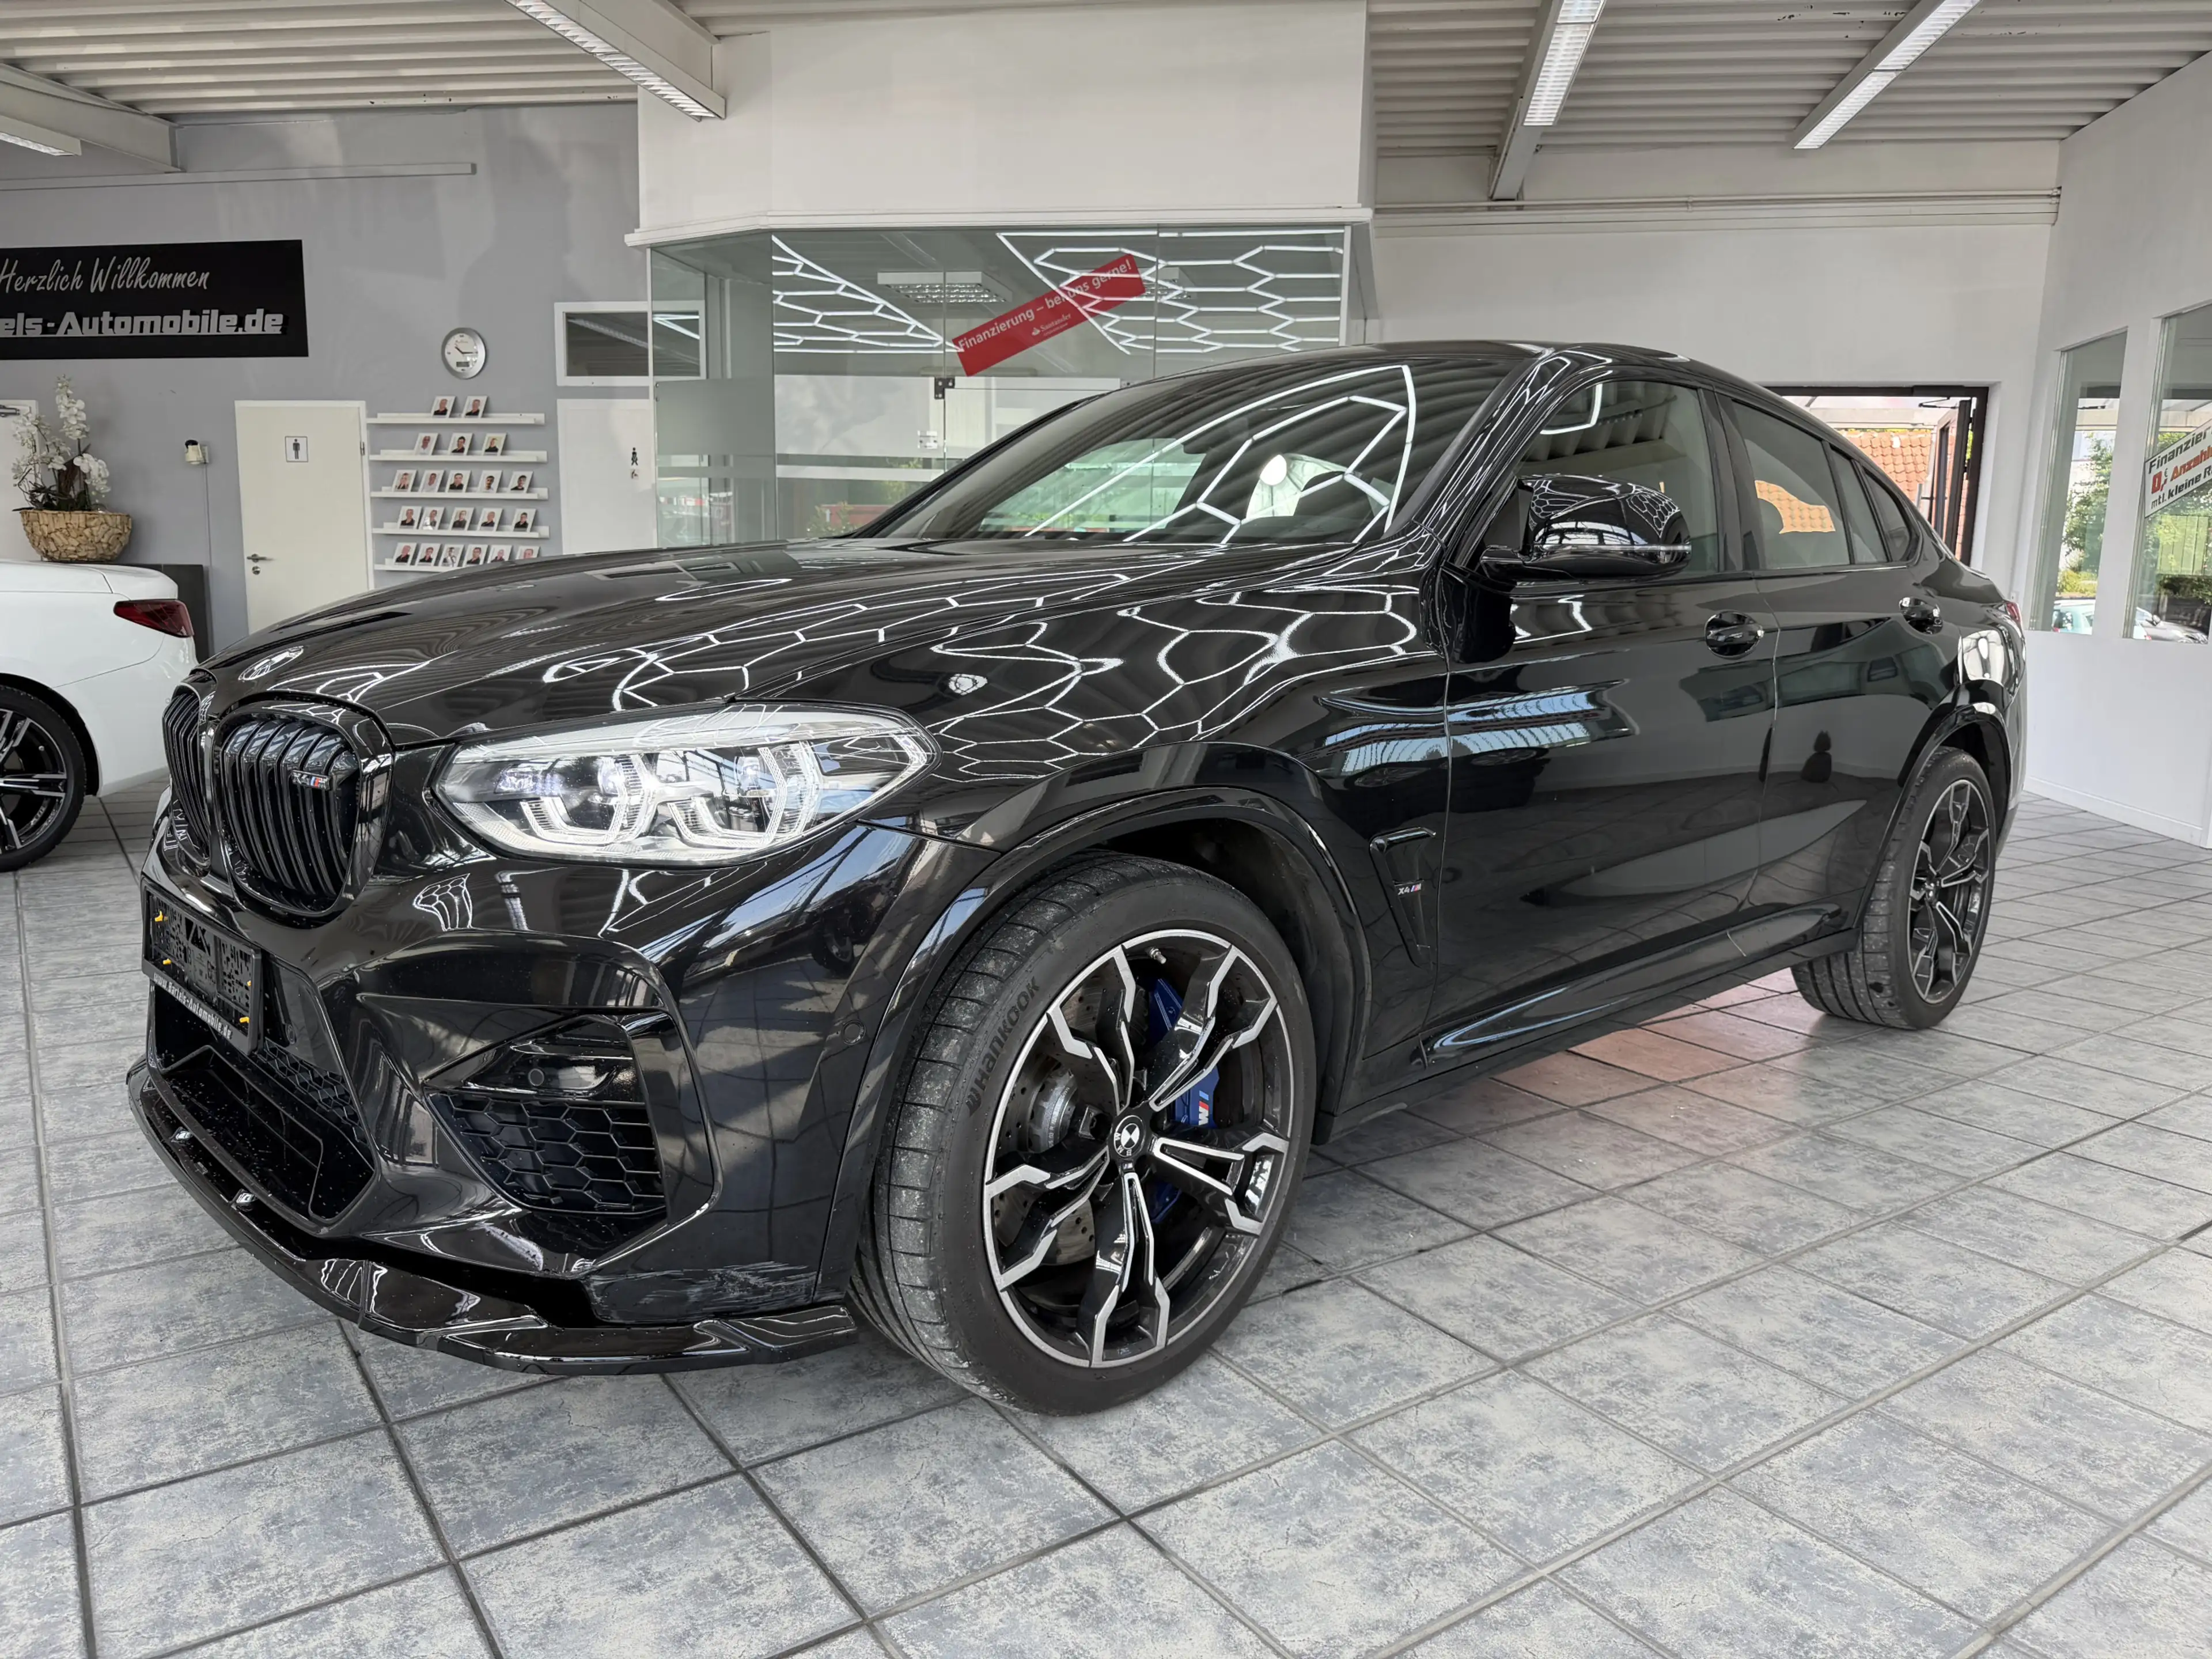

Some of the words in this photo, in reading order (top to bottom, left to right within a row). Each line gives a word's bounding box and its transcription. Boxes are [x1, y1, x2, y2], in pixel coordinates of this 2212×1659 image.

[0, 257, 84, 293] Herzlich
[90, 256, 210, 293] Willkommen
[958, 308, 1036, 350] Finanzierung
[1092, 259, 1132, 289] gerne!
[2148, 426, 2212, 474] Finanzier
[2150, 493, 2167, 509] mtl.
[2168, 472, 2202, 500] kleine
[2203, 463, 2212, 479] R
